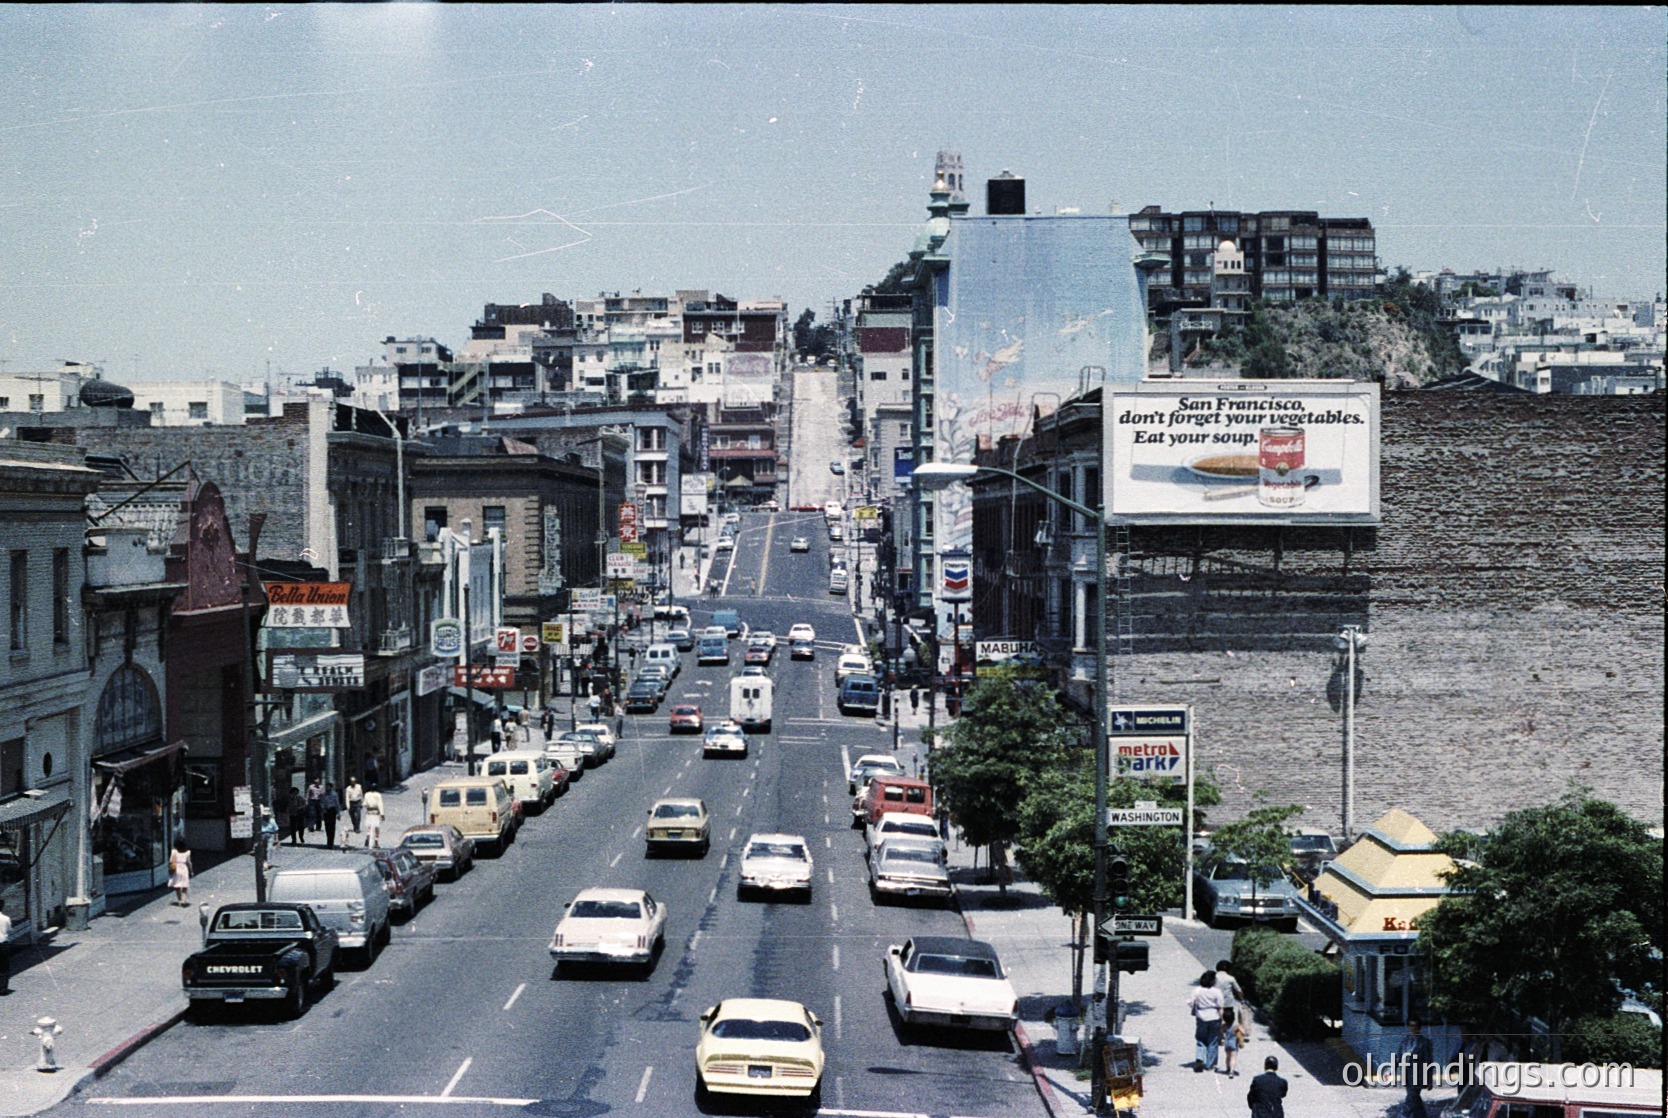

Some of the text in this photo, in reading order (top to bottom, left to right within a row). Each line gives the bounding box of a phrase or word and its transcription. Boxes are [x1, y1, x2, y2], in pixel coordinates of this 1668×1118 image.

[1179, 396, 1306, 412] San Francisco,
[1119, 410, 1365, 427] don't forget your vegetables.
[1134, 430, 1259, 447] Eat your soup.
[269, 585, 347, 604] Bella Union
[1135, 716, 1182, 725] MICHELIN
[1118, 743, 1167, 756] metro
[1118, 755, 1167, 775] park
[1111, 811, 1180, 823] WASHINGTON
[1115, 921, 1155, 930] ONE WAY
[206, 965, 263, 974] CHEVROLET
